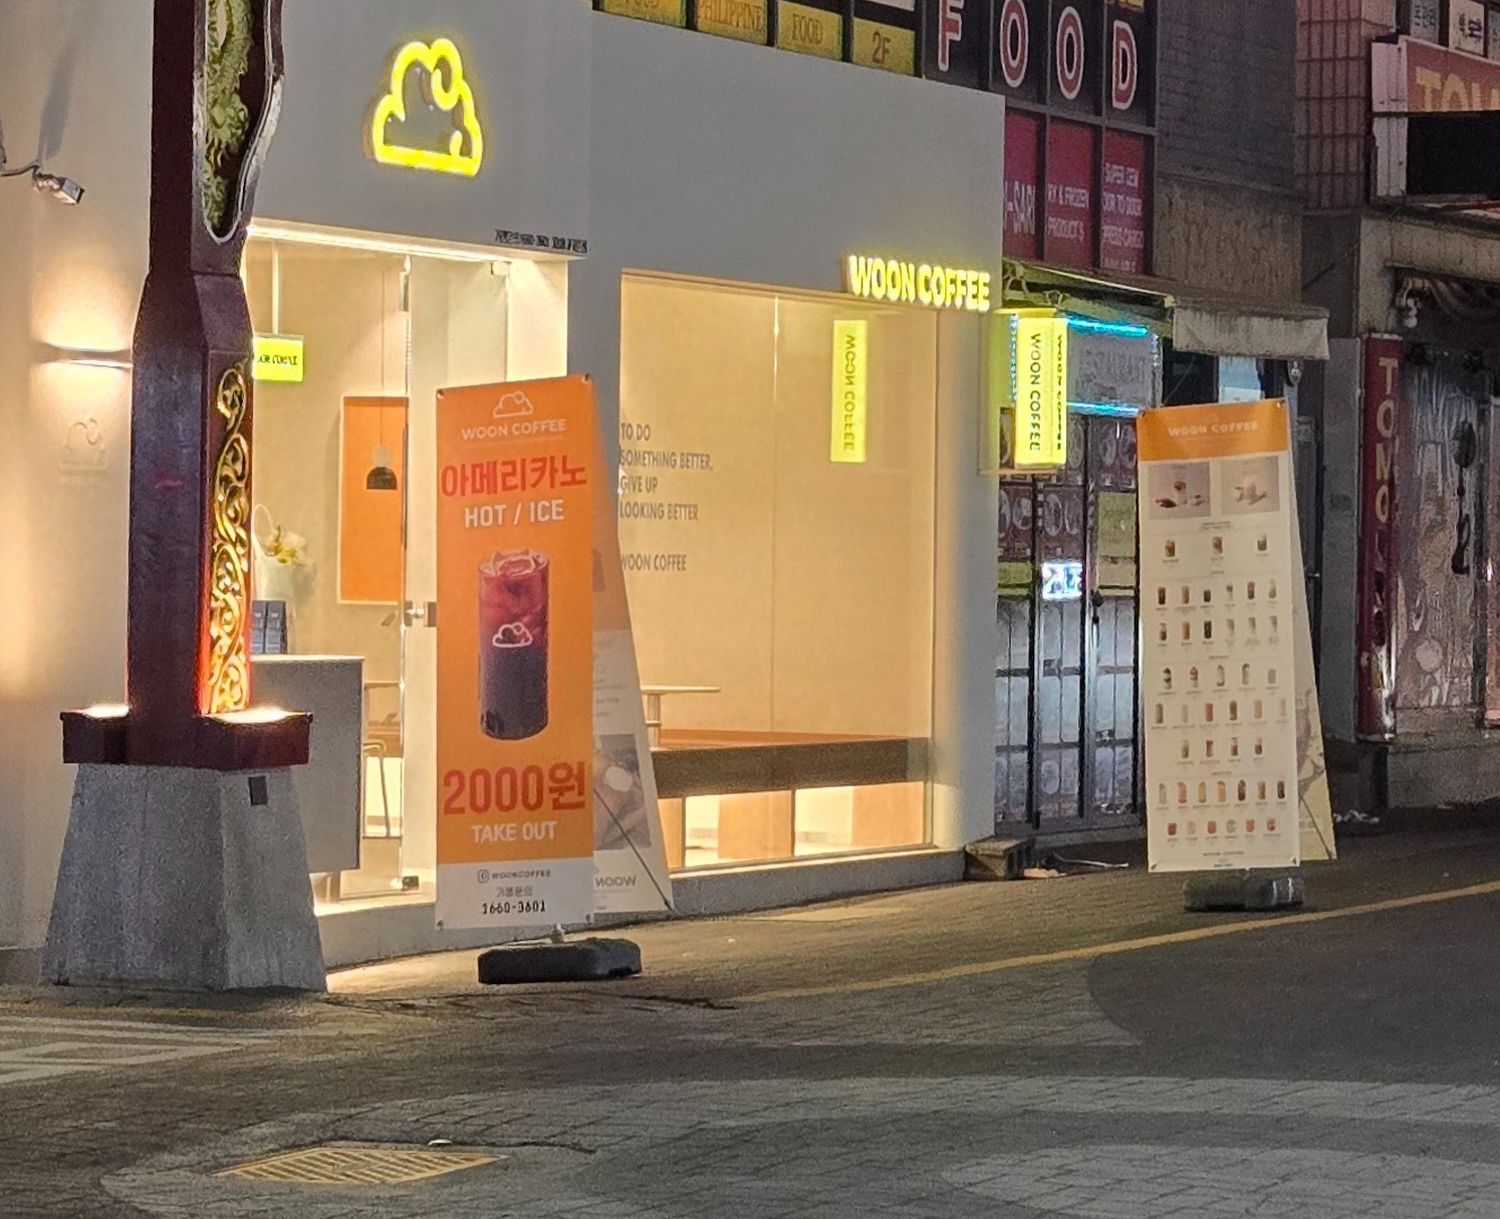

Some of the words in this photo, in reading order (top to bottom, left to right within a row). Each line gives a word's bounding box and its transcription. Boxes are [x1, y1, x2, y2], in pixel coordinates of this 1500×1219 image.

[871, 31, 892, 65] 2F
[849, 255, 915, 304] WOON
[917, 263, 991, 313] COFFEE
[1030, 332, 1043, 385] WOON
[461, 424, 509, 441] WOON
[511, 418, 567, 436] COFFEE
[621, 422, 634, 441] TO
[636, 423, 651, 442] DO
[620, 449, 678, 469] SOMETHING
[441, 454, 588, 498] 아메리카노
[620, 475, 643, 493] GIVE
[645, 476, 659, 494] UP
[464, 503, 507, 529] HOT
[529, 498, 565, 523] ICE
[620, 501, 665, 520] LOOKING
[667, 503, 699, 521] BETTER
[653, 553, 687, 572] COFFEE
[443, 760, 587, 816] 2000원
[470, 822, 518, 844] TAKE
[522, 819, 560, 841] OUT
